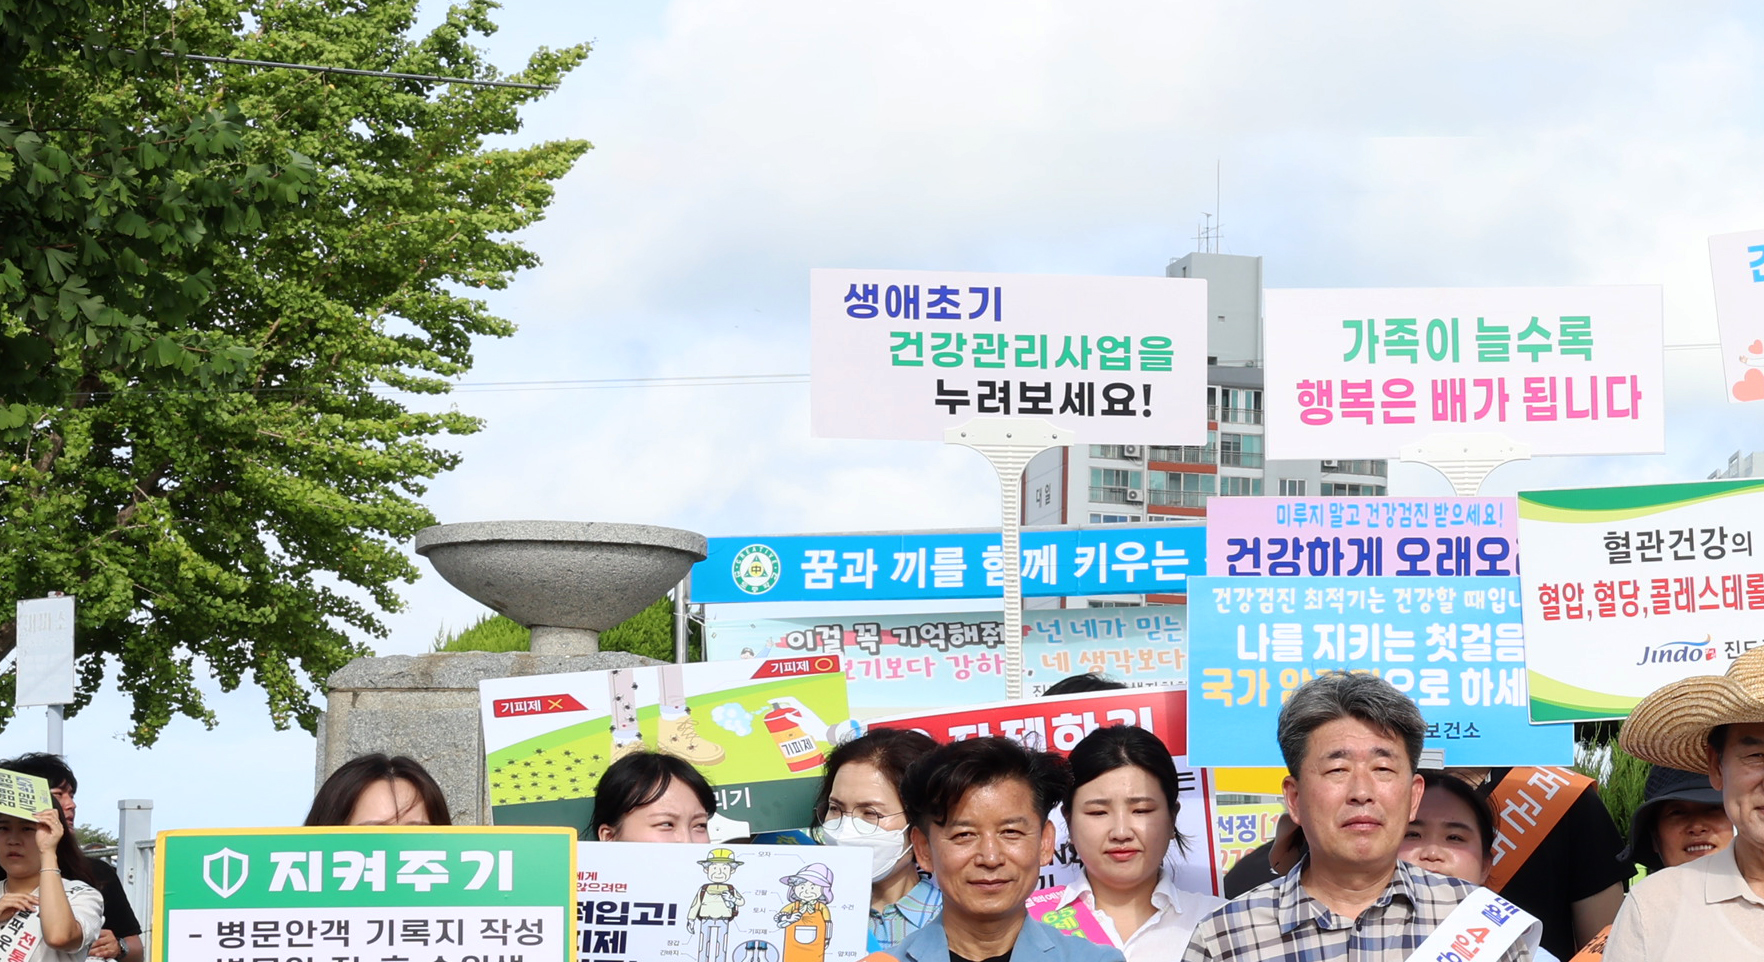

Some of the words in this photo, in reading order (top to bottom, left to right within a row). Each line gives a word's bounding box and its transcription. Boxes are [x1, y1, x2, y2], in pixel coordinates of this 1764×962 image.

[843, 282, 1003, 323] 생애초기
[888, 330, 1176, 373] 건강관리사업을
[1342, 317, 1460, 365] 가족이
[1475, 315, 1595, 363] 늘수록
[934, 379, 1153, 418] 누려보세요!
[1296, 376, 1417, 426] 행복은
[1431, 376, 1509, 423] 배가
[1522, 374, 1642, 422] 됩니다
[1276, 502, 1324, 528] 미루지
[1329, 502, 1361, 528] 말고
[1364, 502, 1429, 529] 건강검진
[1433, 501, 1503, 529] 받으세요!
[800, 547, 878, 590] 꿈과
[890, 546, 967, 586] 끼를
[1074, 540, 1190, 584] 키우는
[1226, 536, 1383, 577] 건강하게
[1395, 536, 1520, 577] 오래오
[1603, 525, 1754, 566] 혈관건강의
[1211, 587, 1296, 614] 건강검진
[1304, 586, 1386, 614] 최적기는
[1393, 586, 1457, 614] 건강할
[787, 624, 844, 658] 이걸
[853, 622, 880, 655] 꼭
[1069, 617, 1126, 643] 네가
[1136, 614, 1185, 643] 믿는
[1237, 622, 1303, 664] 나를
[1312, 621, 1416, 663] 지키는
[1425, 621, 1525, 663] 첫걸음
[1636, 641, 1704, 667] Jindo
[769, 659, 810, 674] 기피제
[1042, 652, 1071, 676] 네
[1078, 647, 1187, 675] 생각보다
[500, 699, 542, 714] 기피제
[1201, 667, 1270, 708] 국가
[268, 848, 514, 893] 지켜주기
[216, 919, 351, 949] 병문안객
[365, 918, 465, 947] 기록지
[479, 918, 545, 946] 작성
